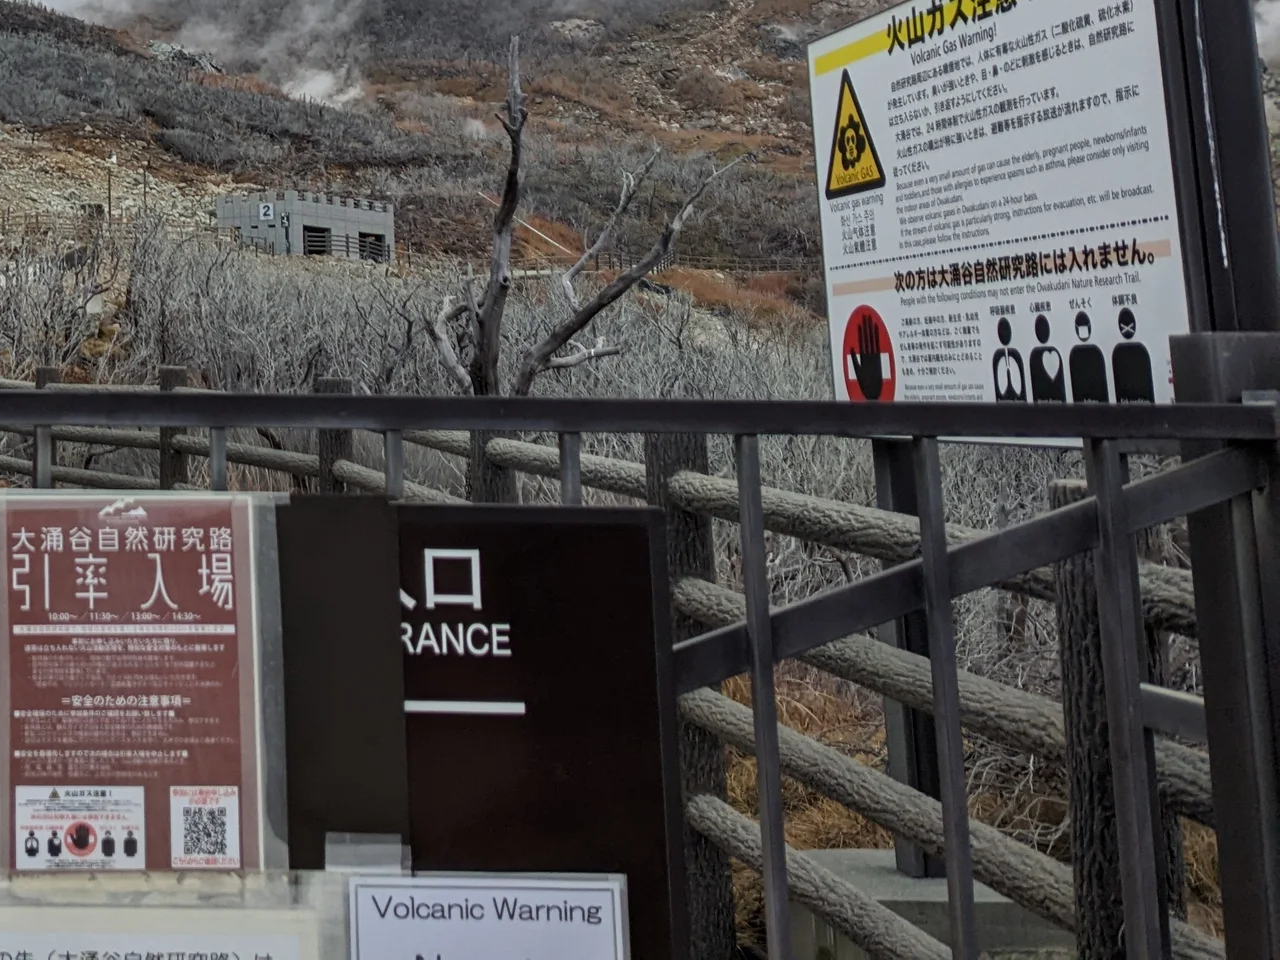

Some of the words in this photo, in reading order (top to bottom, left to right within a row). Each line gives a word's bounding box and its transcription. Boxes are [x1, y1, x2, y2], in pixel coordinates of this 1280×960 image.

[910, 42, 942, 66] Volcanic
[942, 39, 958, 55] Gas
[958, 21, 997, 47] Warning!
[951, 167, 970, 179] amount
[970, 164, 977, 174] of
[977, 163, 986, 173] gas
[986, 161, 996, 171] can
[996, 157, 1011, 168] cause
[1011, 155, 1021, 165] the
[1042, 143, 1069, 159] pregnant
[1069, 138, 1092, 153] people,
[1092, 125, 1148, 146] newborns/infants
[1025, 163, 1038, 175] such
[1038, 163, 1045, 173] as
[1067, 154, 1086, 168] please
[1086, 148, 1111, 162] consider
[1111, 145, 1126, 158] only
[1126, 140, 1150, 153] visiting
[835, 170, 860, 186] Volcanic
[860, 165, 874, 179] GAS
[262, 204, 271, 217] 2
[829, 200, 851, 213] Volcanic
[861, 193, 884, 206] warning
[1043, 201, 1052, 212] for
[1053, 197, 1086, 211] evacuation,
[1099, 190, 1111, 202] will
[1111, 189, 1120, 200] be
[1120, 183, 1155, 198] broadcast.
[893, 237, 1155, 294] 次の方は大涌谷自然研究路には入れません。
[936, 291, 960, 303] following
[960, 289, 987, 300] conditions
[987, 288, 999, 299] may
[1000, 286, 1009, 297] not
[1010, 285, 1025, 295] enter
[1026, 283, 1036, 294] the
[1036, 279, 1071, 293] Owakudani
[1071, 276, 1094, 289] Nature
[1094, 274, 1123, 287] Research
[1124, 270, 1142, 283] Trail.
[1111, 292, 1138, 307] 体調不良
[1068, 297, 1092, 310] ぜんそく
[11, 525, 233, 553] 大涌谷自然研究路
[11, 553, 234, 611] 引率入場
[371, 894, 485, 921] Volcanic
[491, 896, 603, 925] Warning
